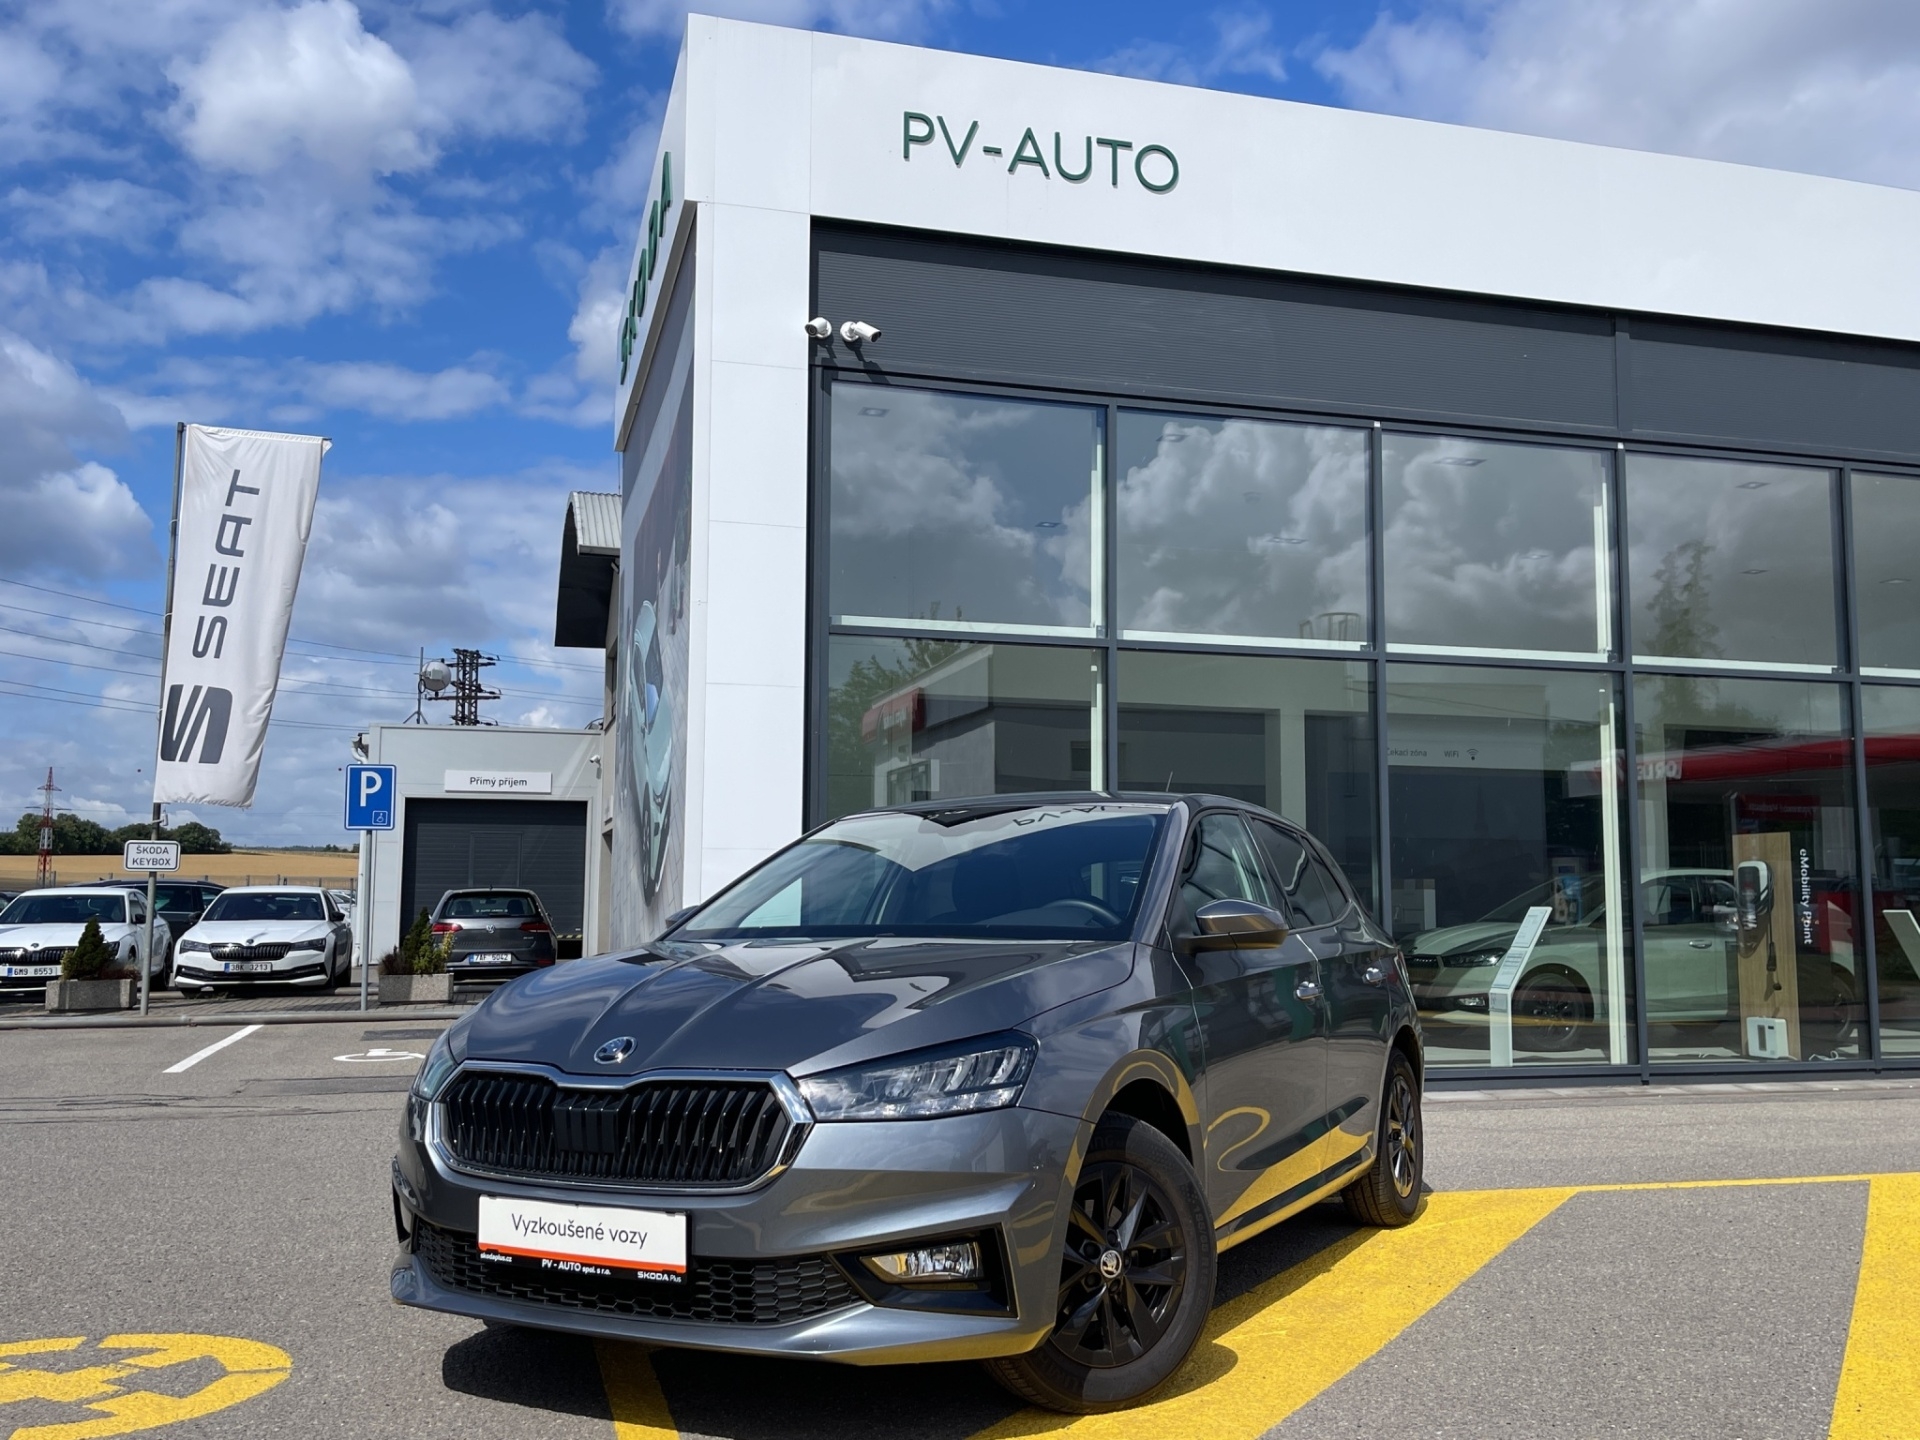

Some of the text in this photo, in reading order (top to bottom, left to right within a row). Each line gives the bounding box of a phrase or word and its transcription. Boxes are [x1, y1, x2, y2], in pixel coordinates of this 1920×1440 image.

[903, 111, 1179, 193] PV-AUTO
[191, 468, 261, 660] SEAT
[360, 770, 383, 807] P
[469, 776, 528, 788] Přímý příjem
[132, 857, 172, 867] KEYBOX
[136, 844, 170, 855] ŠKODA
[1799, 848, 1814, 945] eMobility Point
[511, 1213, 648, 1250] Vyzkoušené vozy
[541, 1258, 553, 1269] PV
[558, 1261, 582, 1272] AUTO
[669, 1274, 682, 1283] Plus
